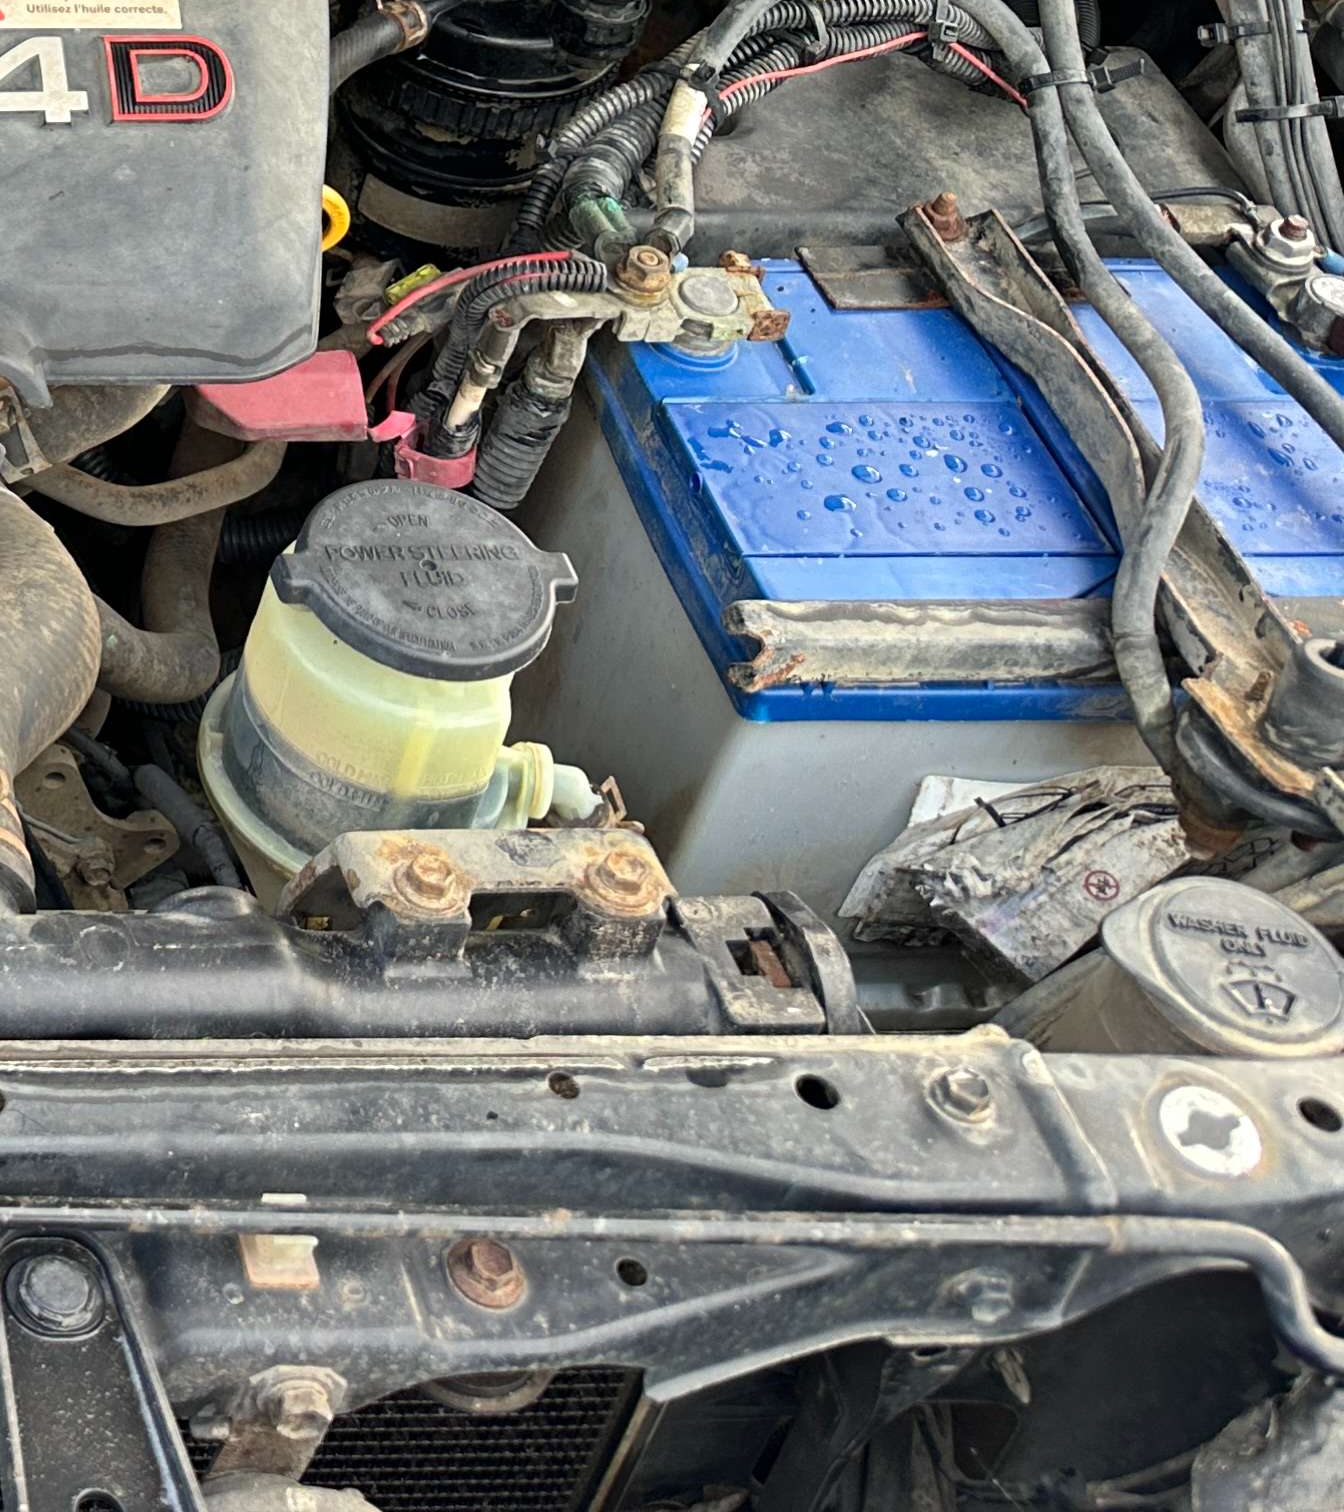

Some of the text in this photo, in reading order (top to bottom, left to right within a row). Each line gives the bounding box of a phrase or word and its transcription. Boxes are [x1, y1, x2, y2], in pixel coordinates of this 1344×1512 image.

[26, 4, 167, 14] Utilisez l'huile correcte.
[387, 513, 429, 528] OPEN
[325, 544, 520, 562] POWER STEERING
[400, 569, 465, 589] FLUID
[426, 603, 475, 620] CLOSE
[1167, 913, 1311, 948] WASHER FLUID
